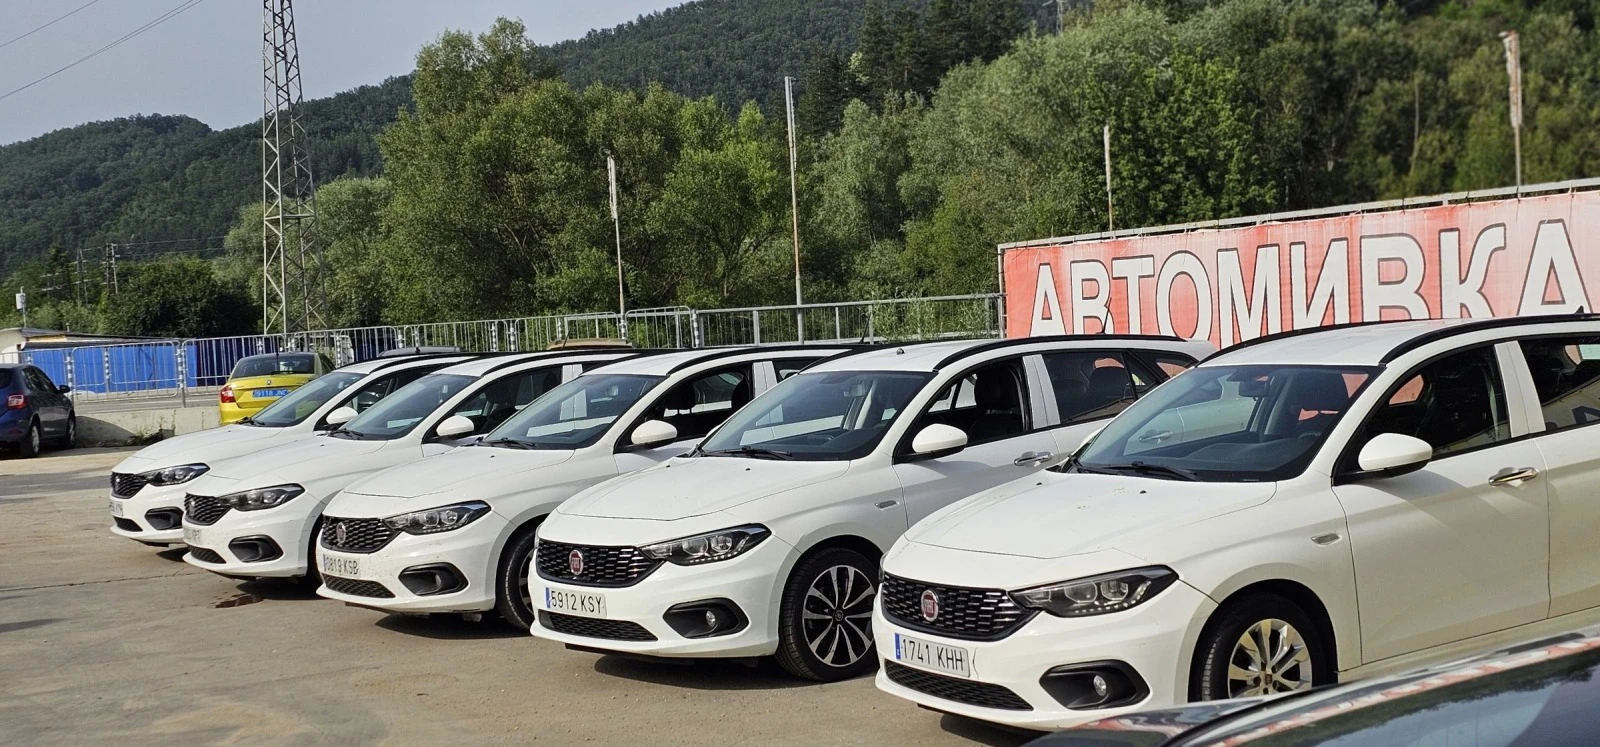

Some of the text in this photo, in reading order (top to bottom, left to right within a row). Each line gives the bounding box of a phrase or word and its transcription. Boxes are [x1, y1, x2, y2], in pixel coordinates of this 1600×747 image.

[1029, 218, 1593, 350] АВТОМИВКА
[551, 590, 602, 614] 5912 KSY
[903, 638, 964, 671] 1741 KHH
